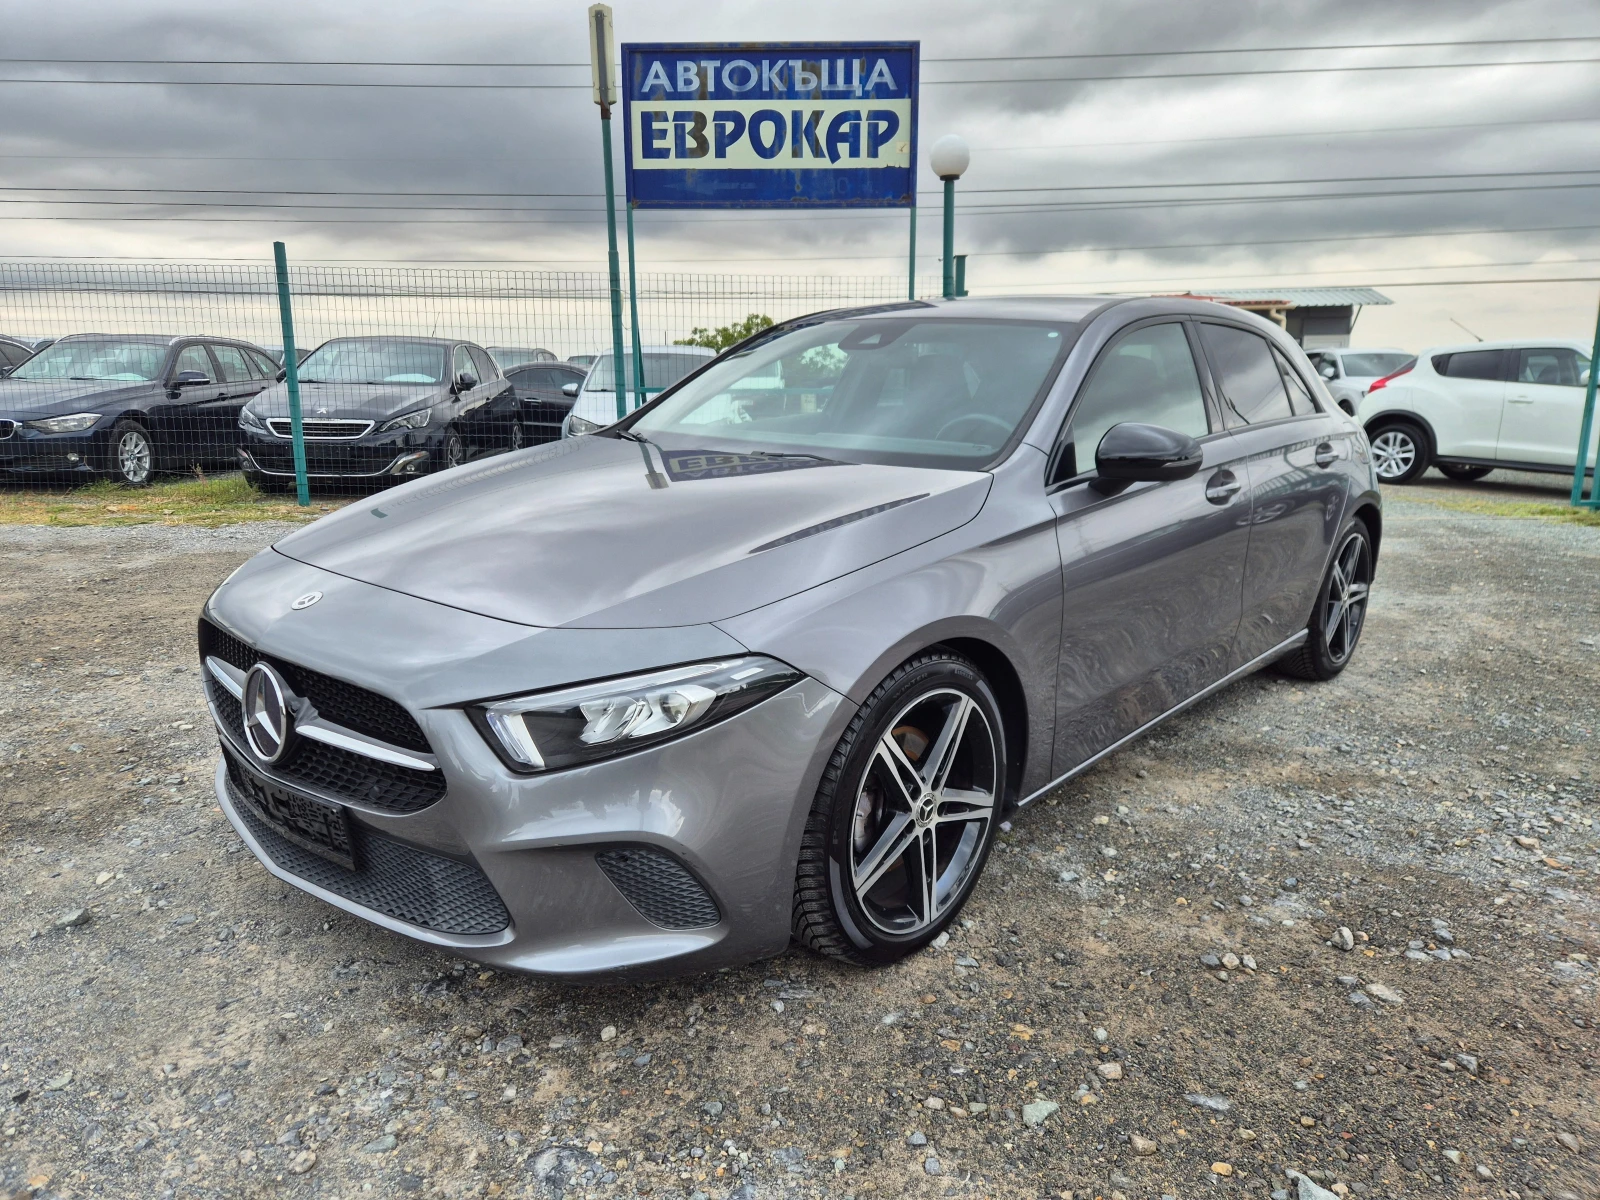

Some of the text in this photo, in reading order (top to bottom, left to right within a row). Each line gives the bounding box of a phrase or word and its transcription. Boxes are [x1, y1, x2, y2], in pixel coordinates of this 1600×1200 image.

[640, 58, 898, 97] АВТОКЪЩА
[640, 109, 900, 165] ЕВРОКАР
[893, 672, 928, 699] WINTER
